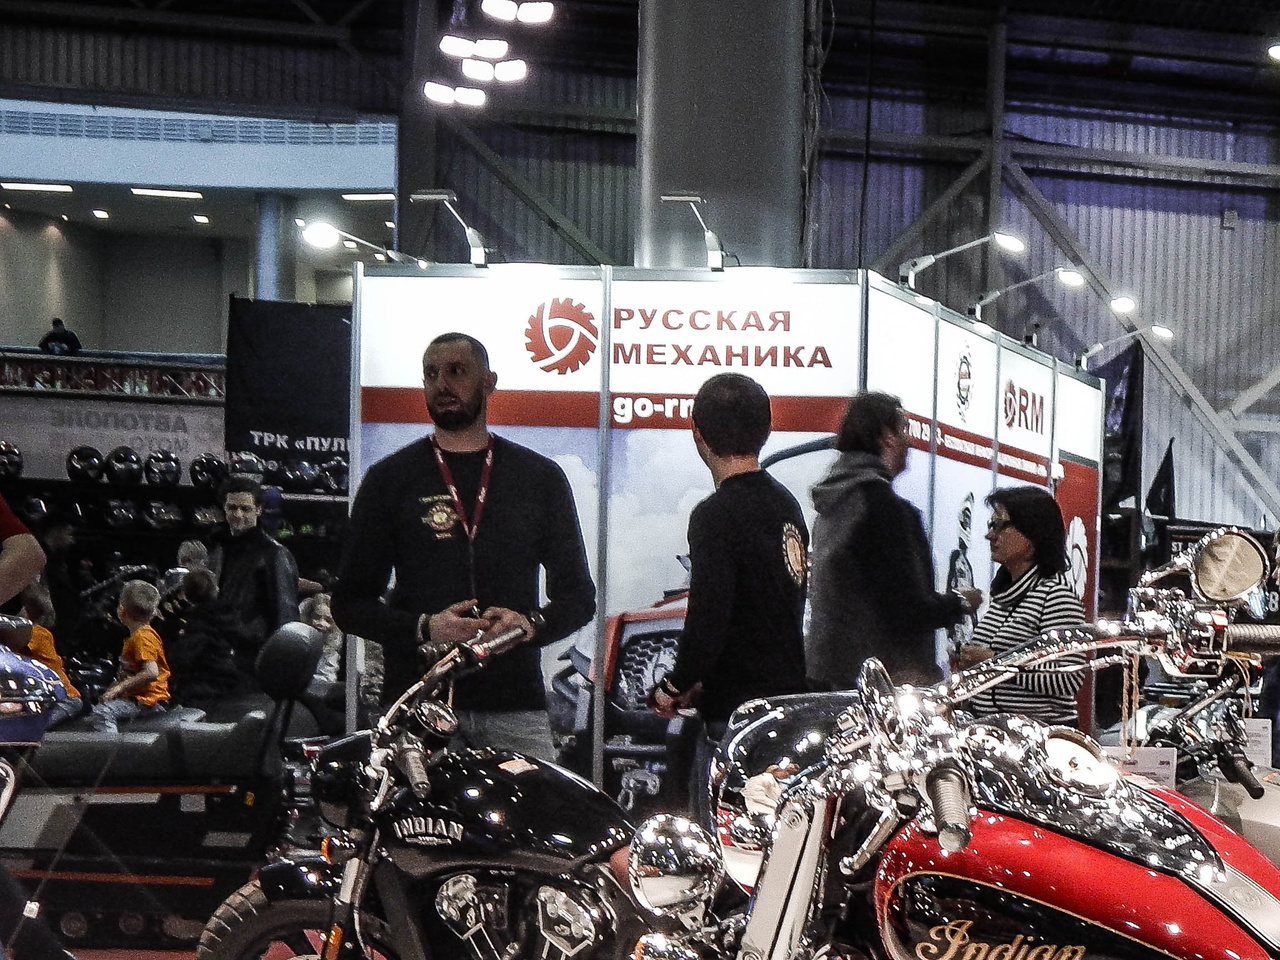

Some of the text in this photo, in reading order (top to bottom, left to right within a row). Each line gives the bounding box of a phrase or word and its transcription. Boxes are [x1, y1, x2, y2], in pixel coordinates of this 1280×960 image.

[613, 307, 792, 332] РУССКАЯ
[613, 342, 833, 369] МЕХАНИКА
[1018, 387, 1044, 435] RM
[249, 430, 350, 452] ТРК «ПУЛ
[393, 816, 464, 841] INDIAN
